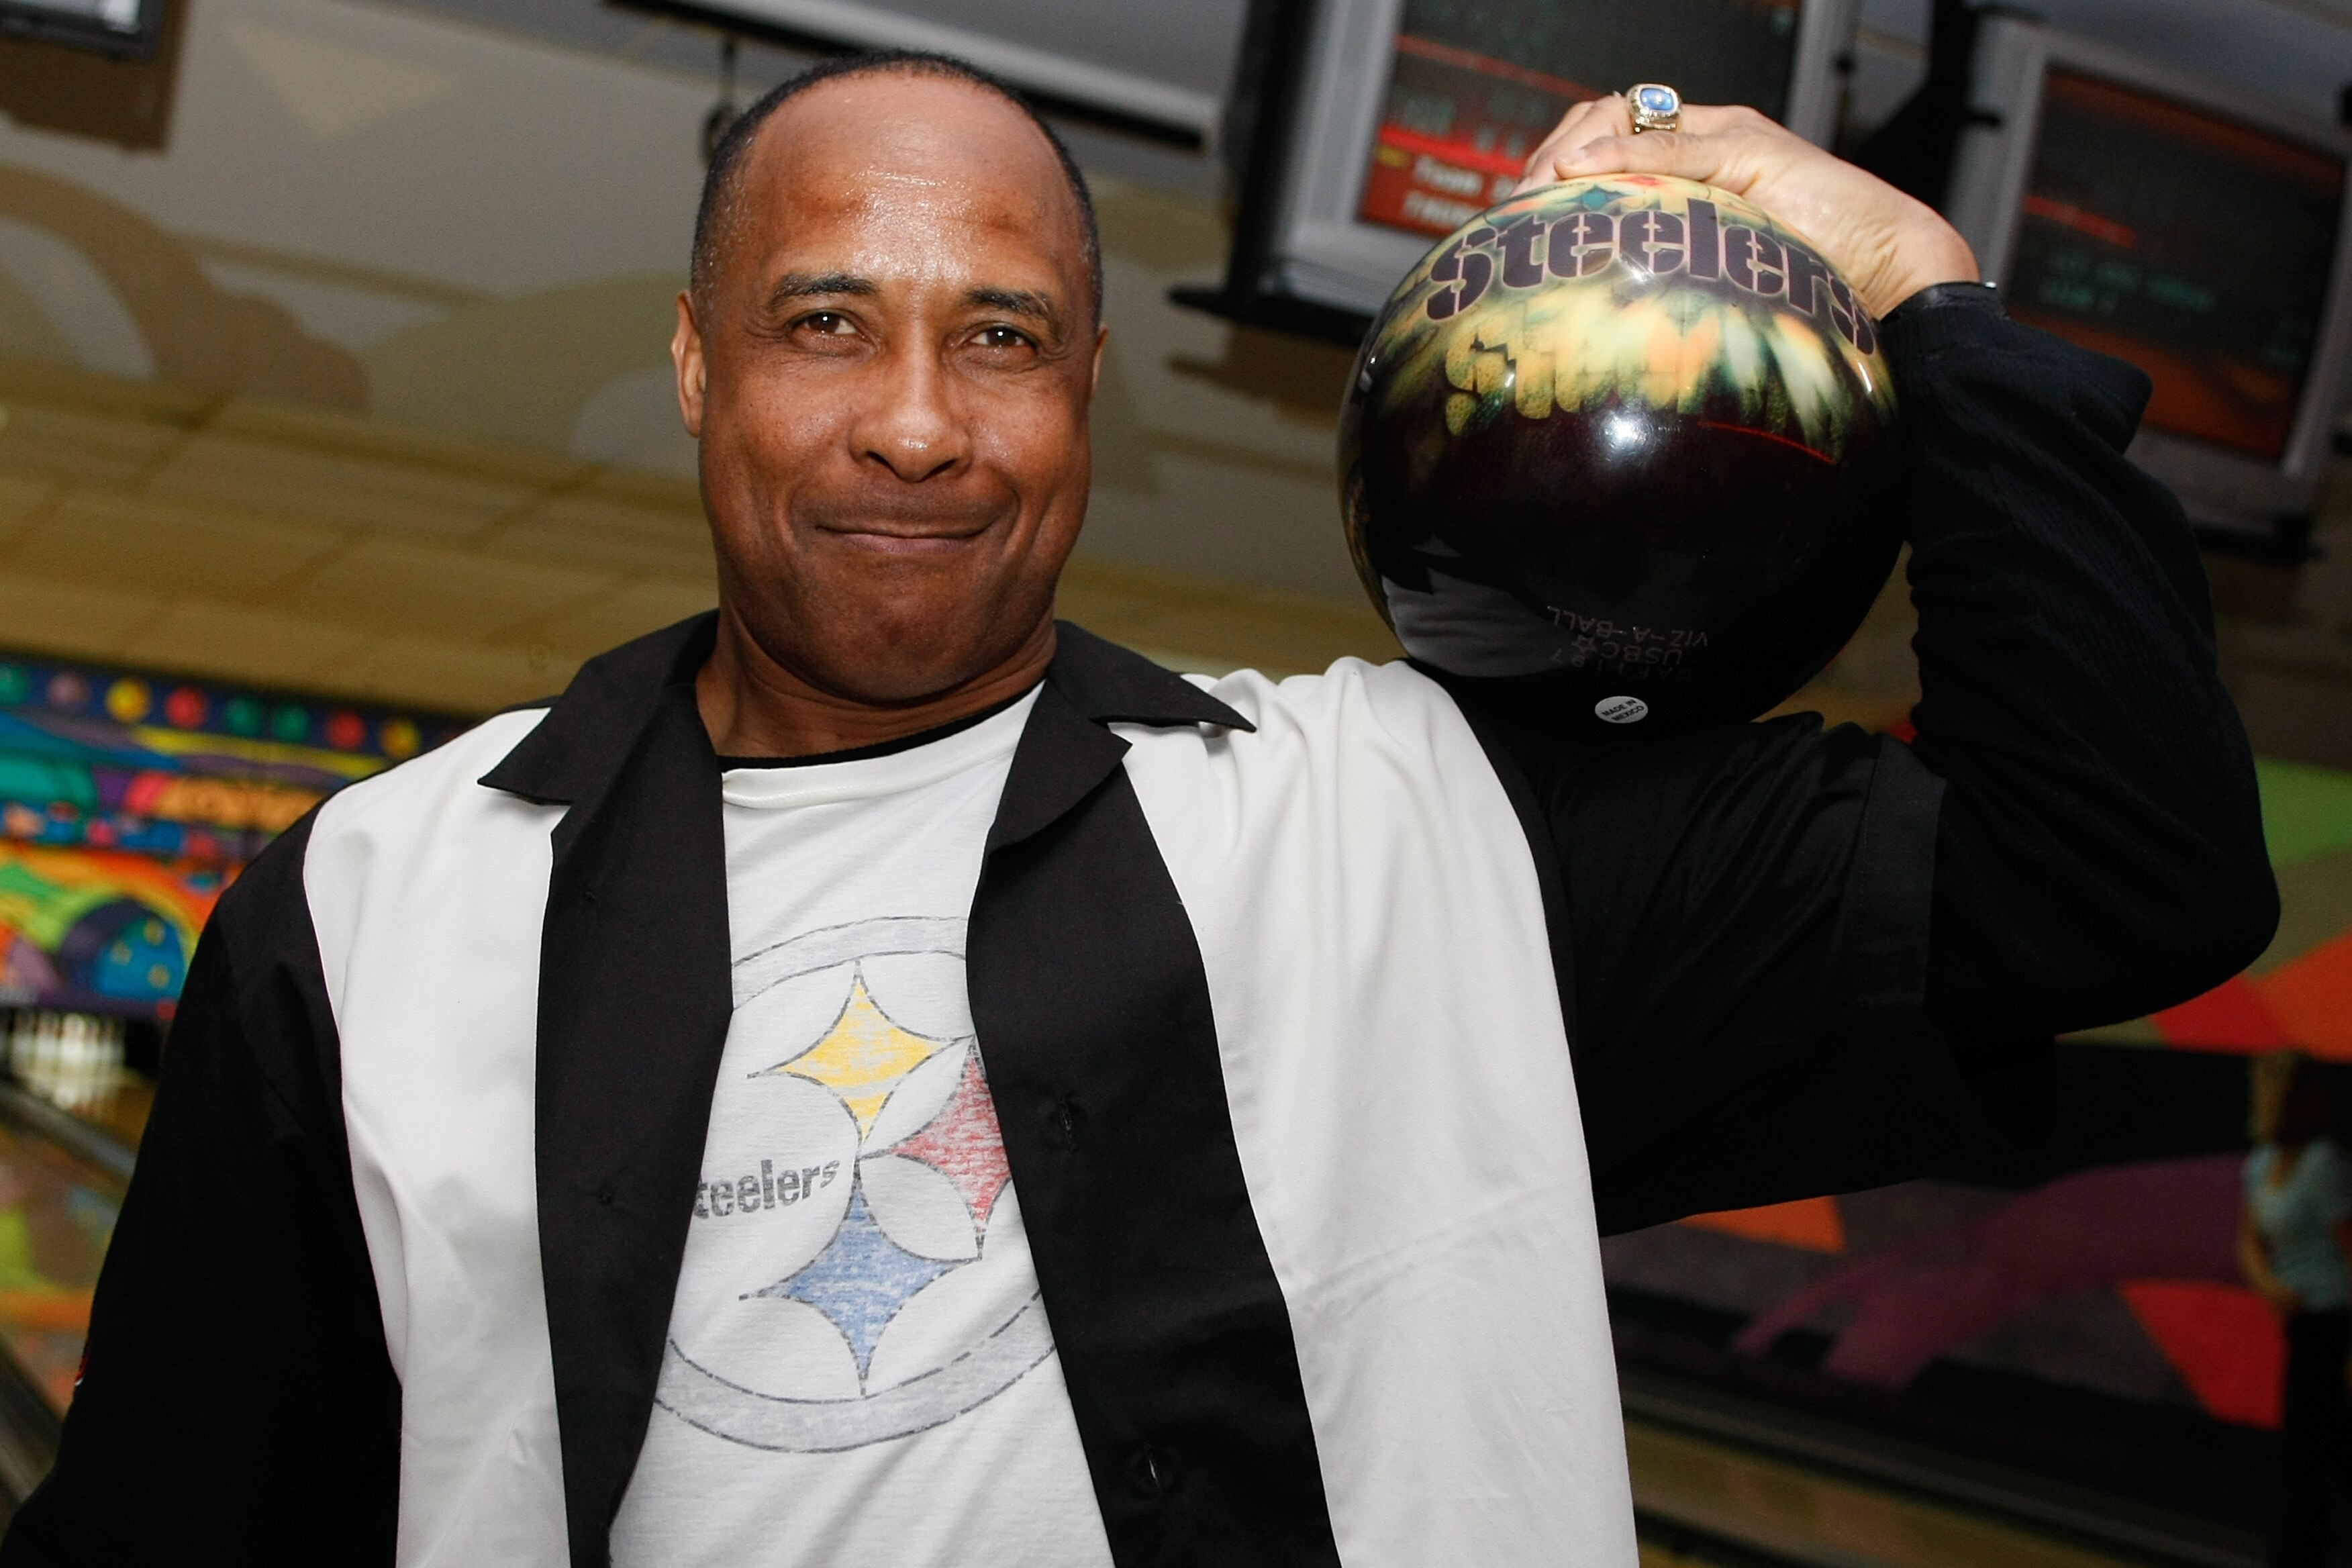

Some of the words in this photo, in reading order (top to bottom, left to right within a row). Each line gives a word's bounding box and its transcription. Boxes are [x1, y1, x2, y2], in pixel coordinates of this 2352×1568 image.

[1426, 199, 1876, 355] Steelers
[1547, 605, 1708, 648] VIZ-A-BALL
[1599, 640, 1683, 667] USBC
[1602, 704, 1626, 716] MADE
[1612, 705, 1644, 721] MEXICO
[693, 1159, 840, 1219] teelers
